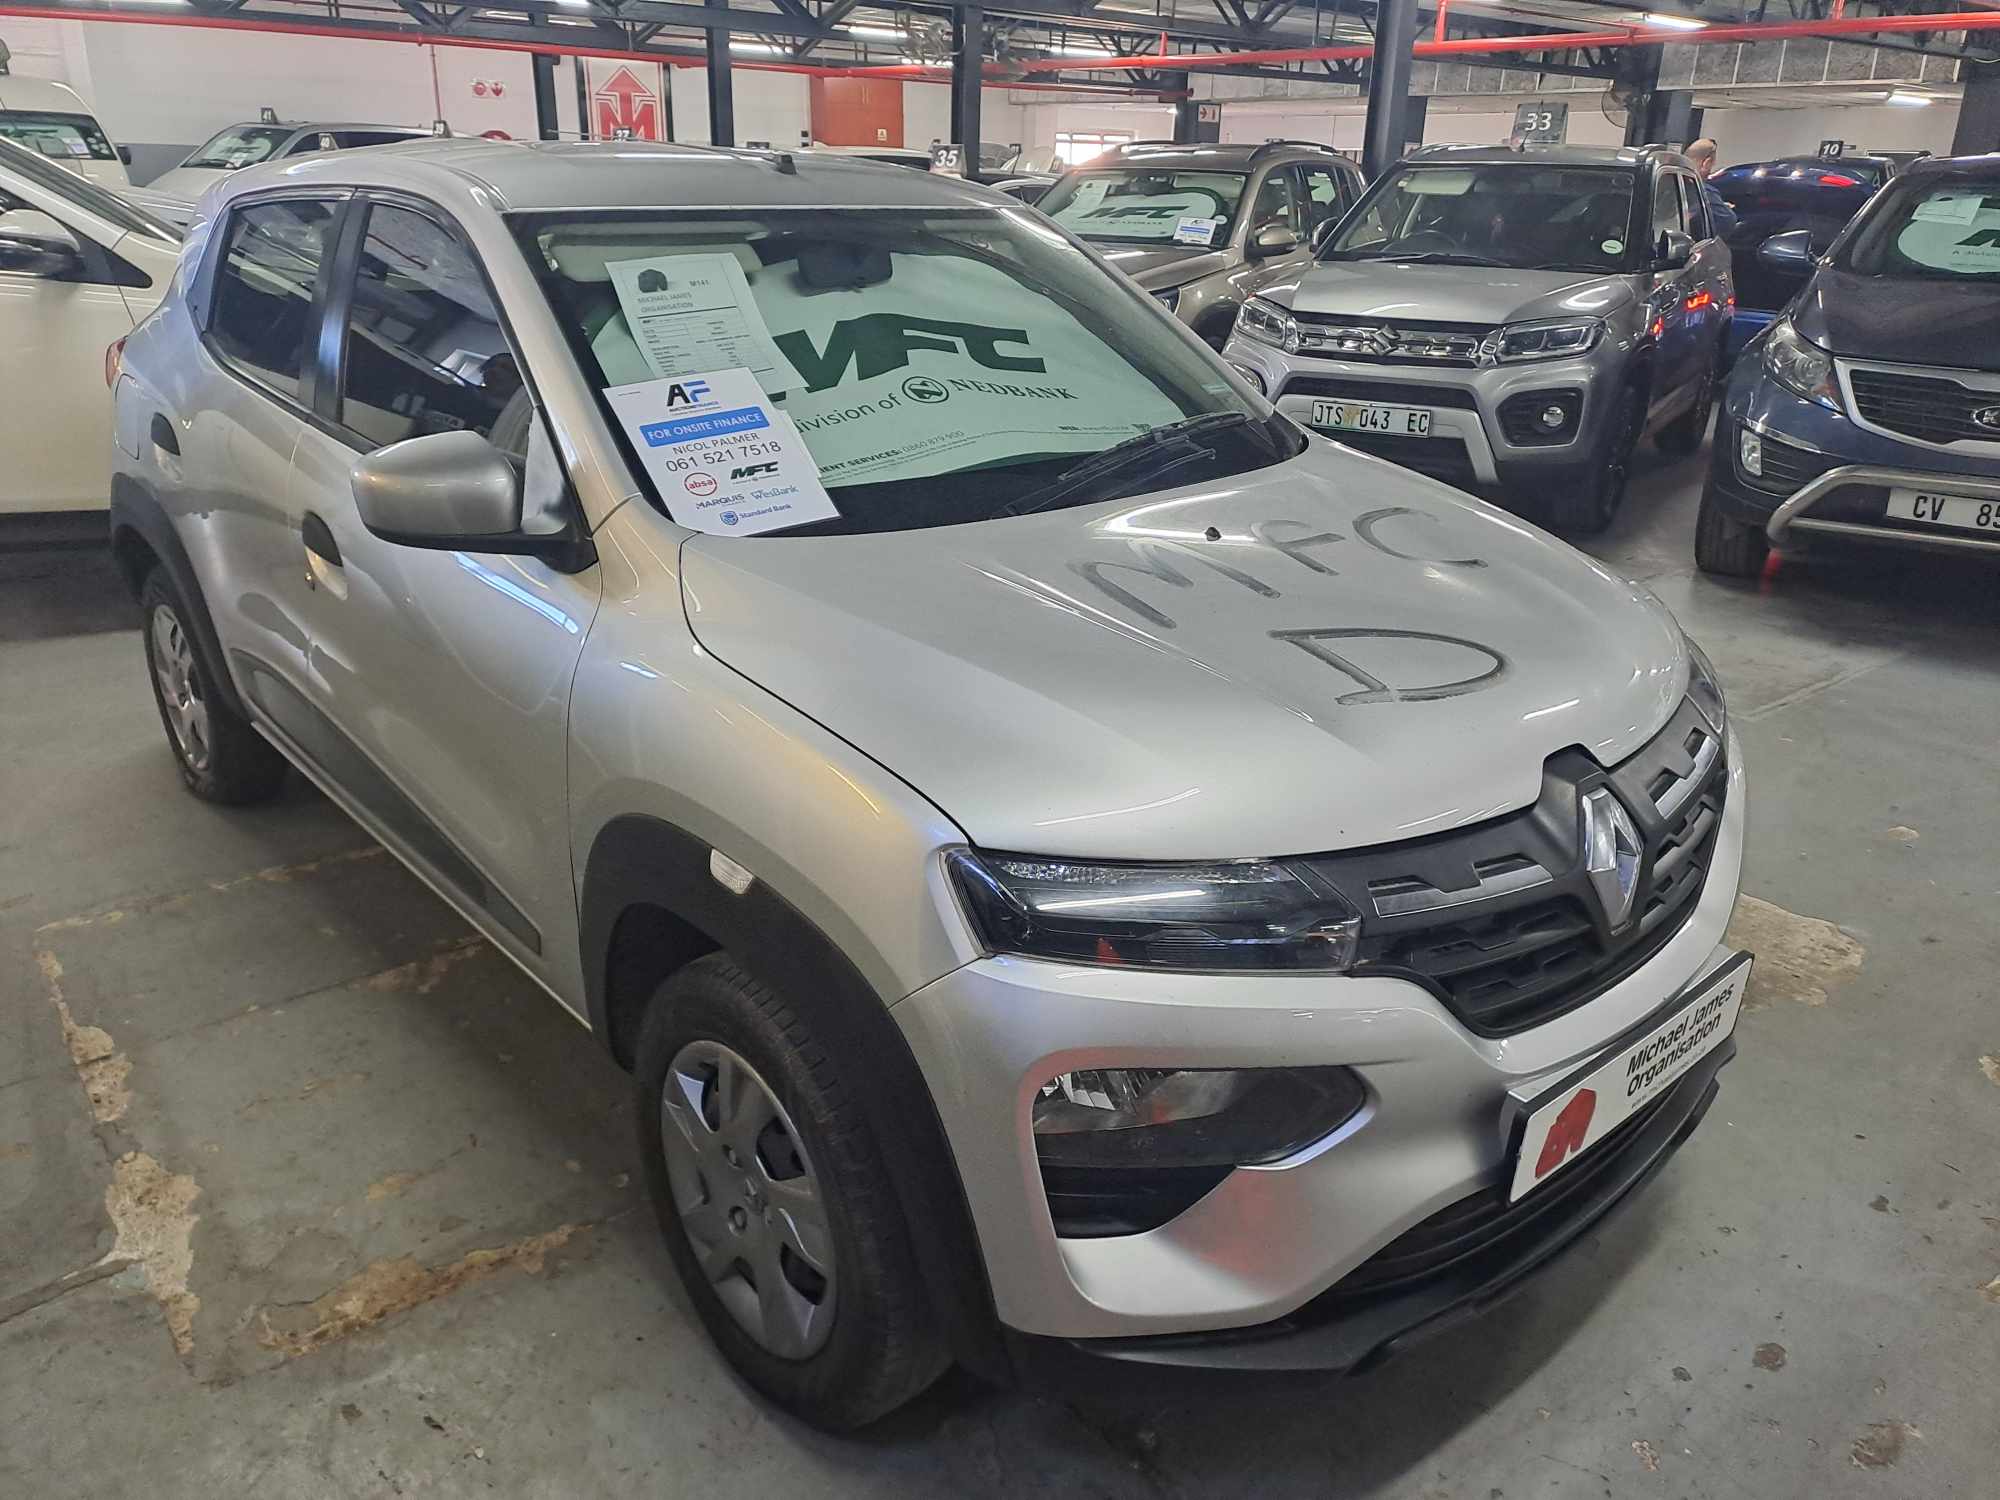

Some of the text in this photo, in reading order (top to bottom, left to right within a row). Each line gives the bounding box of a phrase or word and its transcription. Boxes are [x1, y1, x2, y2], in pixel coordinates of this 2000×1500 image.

[1525, 112, 1552, 131] 33
[935, 149, 958, 167] 35
[1823, 143, 1840, 155] 10
[1078, 205, 1191, 219] MFC
[640, 302, 694, 313] ORGANISATION
[666, 380, 711, 407] AF
[878, 392, 902, 410] of
[947, 378, 1079, 400] NEDBANK
[647, 412, 762, 441] FOR ONSITE FINANCE
[1315, 404, 1428, 433] JTS 043 EC
[672, 432, 760, 455] NICOL PALMER
[665, 441, 782, 473] 061 521 7518
[847, 449, 903, 466] SERVICES:
[688, 480, 714, 491] absa
[730, 461, 779, 480] MFC
[696, 493, 745, 510] MARQUIS
[740, 503, 792, 519] Standard Bank
[1913, 495, 1945, 521] CV
[1266, 628, 1512, 706] D
[1626, 1015, 1690, 1078] Michael
[1689, 983, 1734, 1030] James
[1626, 1013, 1721, 1097] Organisation
